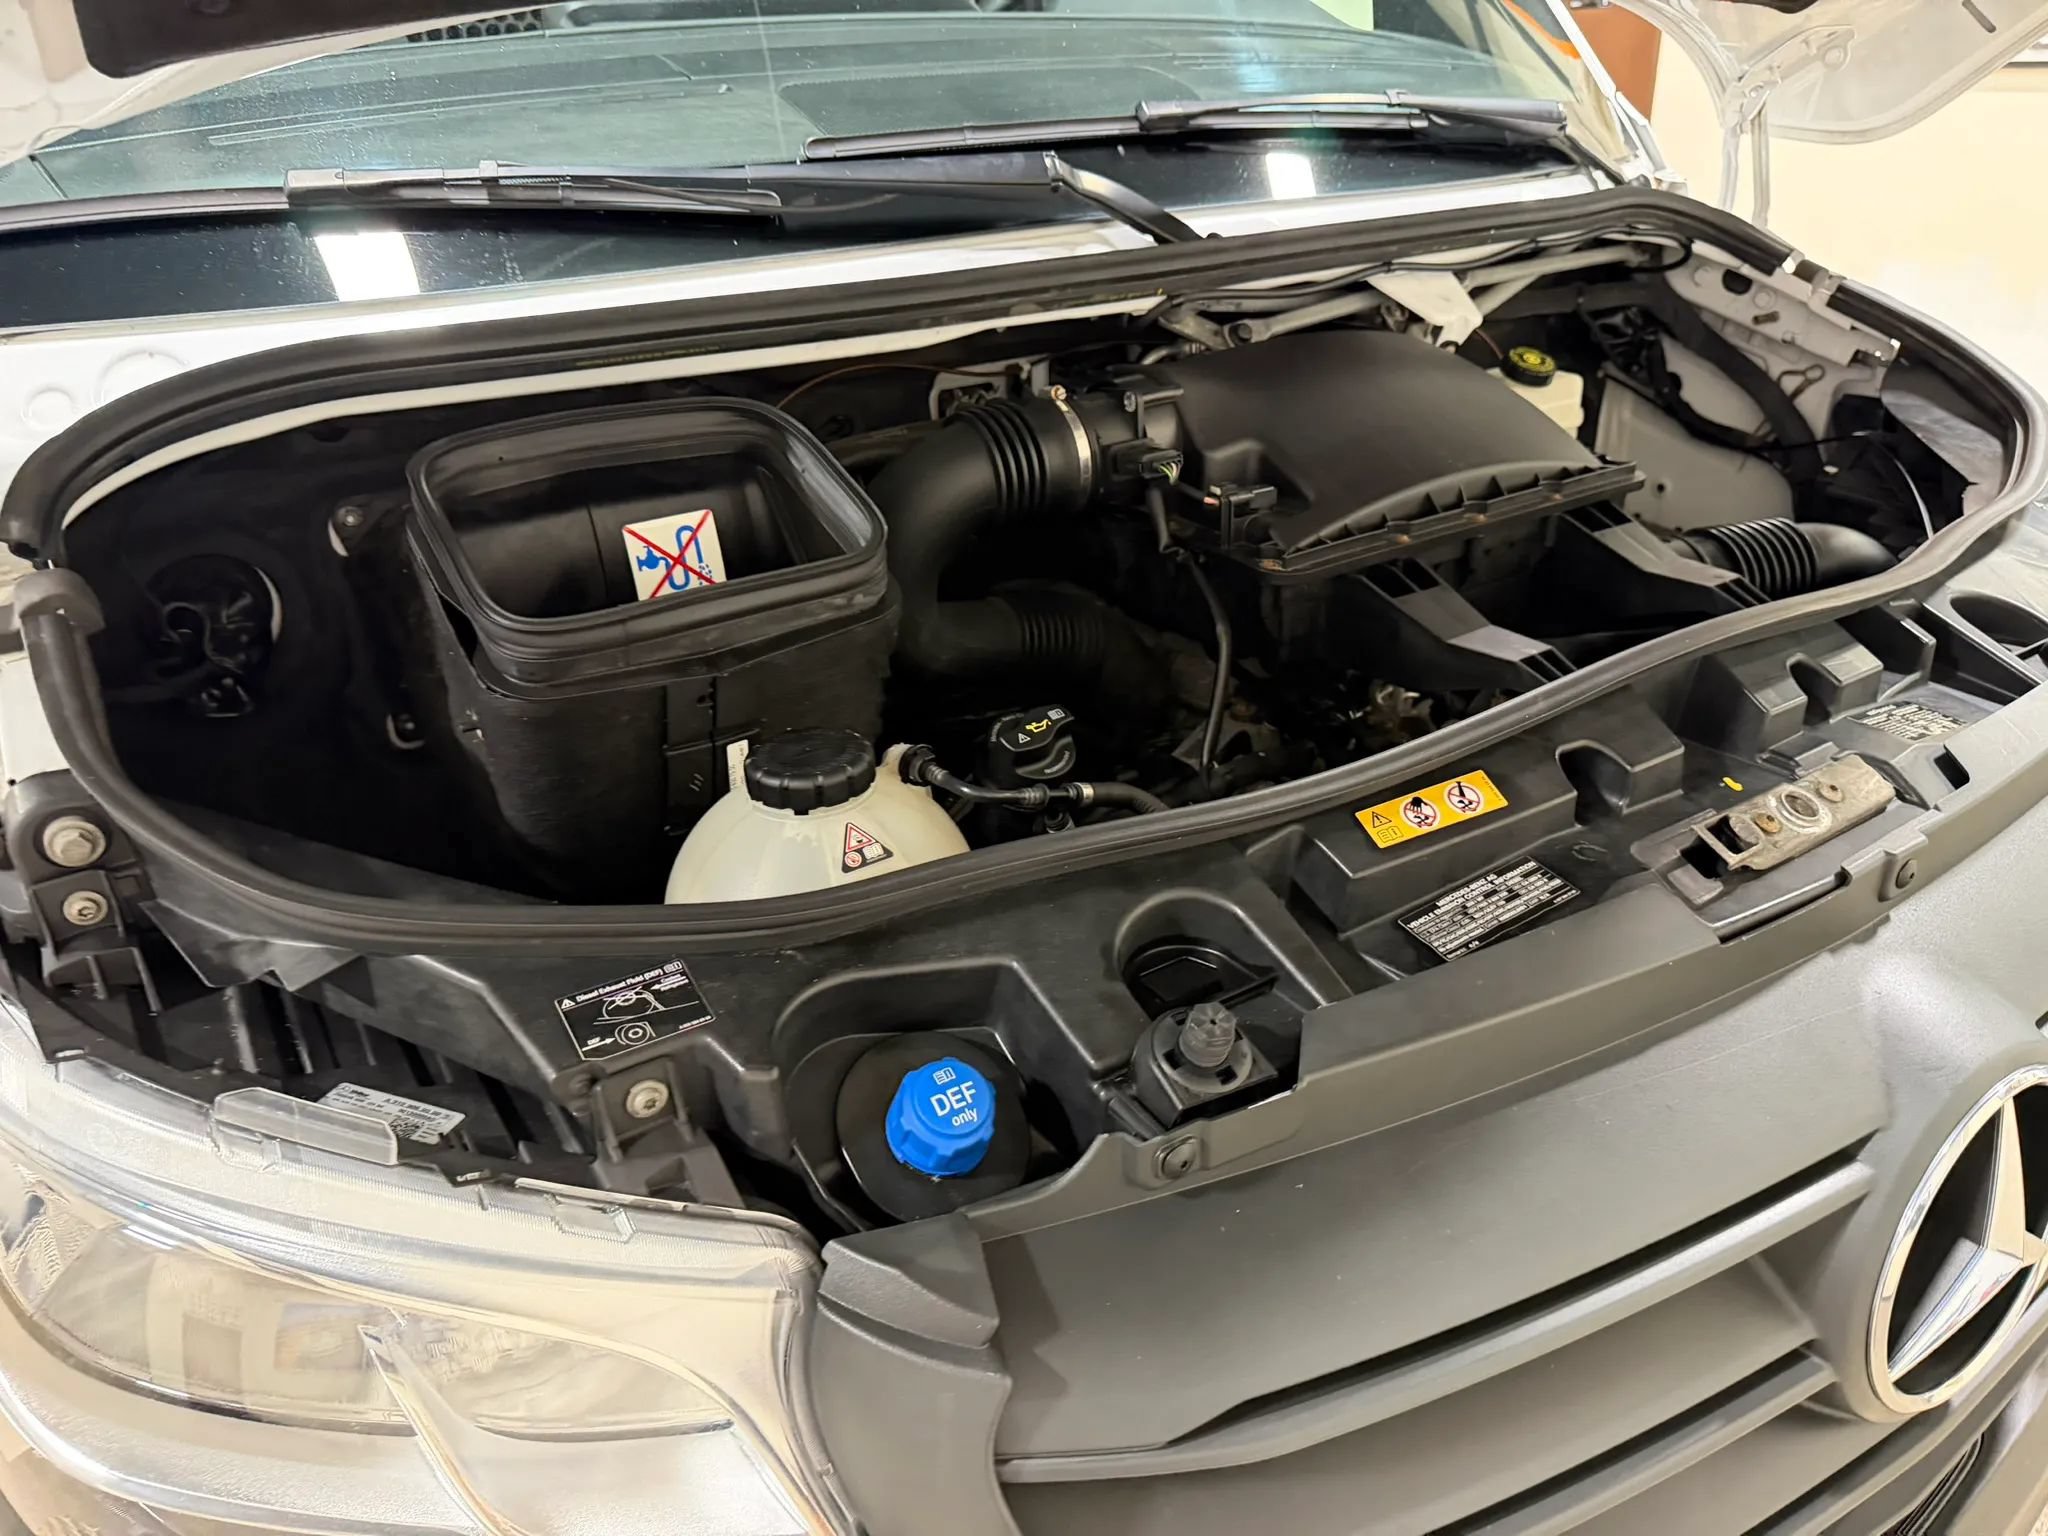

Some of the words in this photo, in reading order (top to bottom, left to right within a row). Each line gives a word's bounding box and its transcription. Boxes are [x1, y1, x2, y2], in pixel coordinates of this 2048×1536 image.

[1407, 911, 1436, 929] VEHICLE
[1433, 897, 1466, 915] EMISSION
[1464, 882, 1496, 899] CONTROL
[1492, 861, 1537, 885] INFORMATION
[1435, 878, 1488, 906] MERCEDES-BENZ
[576, 990, 599, 1002] Diesel
[598, 981, 627, 995] Exhaust
[626, 974, 645, 985] Fluid
[643, 968, 664, 980] (DEF)
[930, 1081, 977, 1117] DEF
[952, 1107, 978, 1127] only
